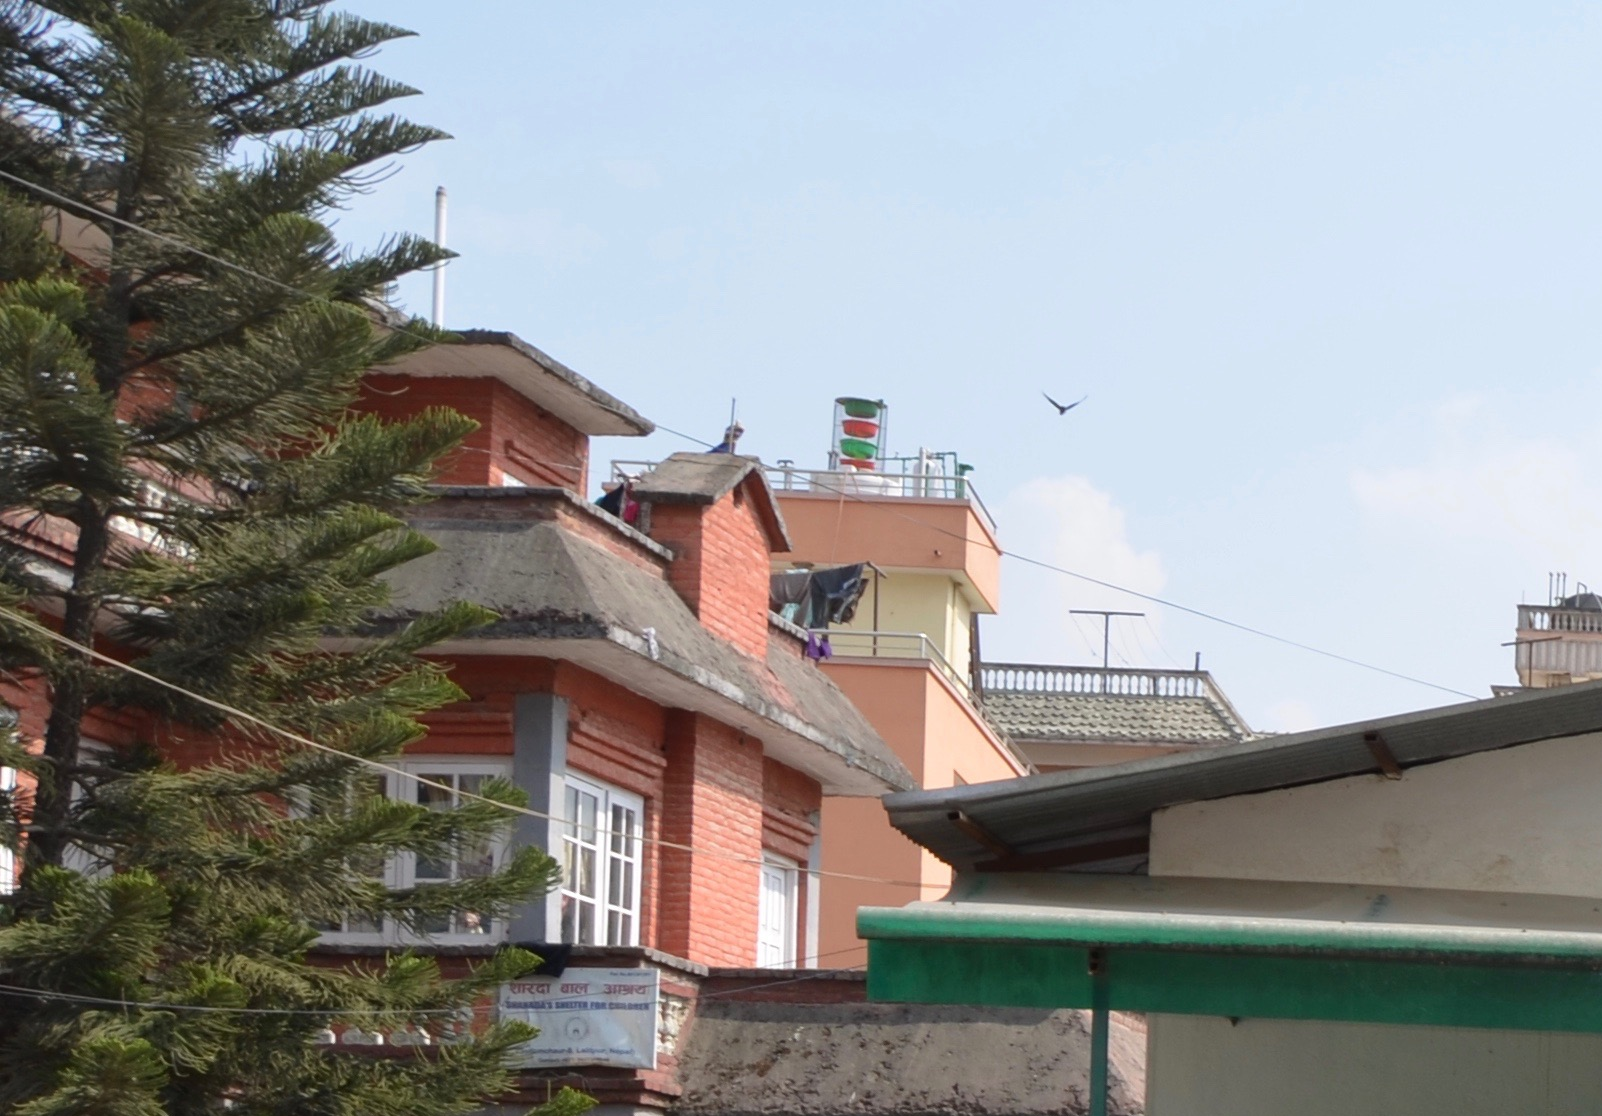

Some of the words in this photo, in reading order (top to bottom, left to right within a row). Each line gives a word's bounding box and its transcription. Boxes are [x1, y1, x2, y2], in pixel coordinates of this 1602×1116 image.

[509, 982, 551, 994] शारदा
[560, 982, 590, 994] बाल
[590, 1001, 607, 1010] FOR
